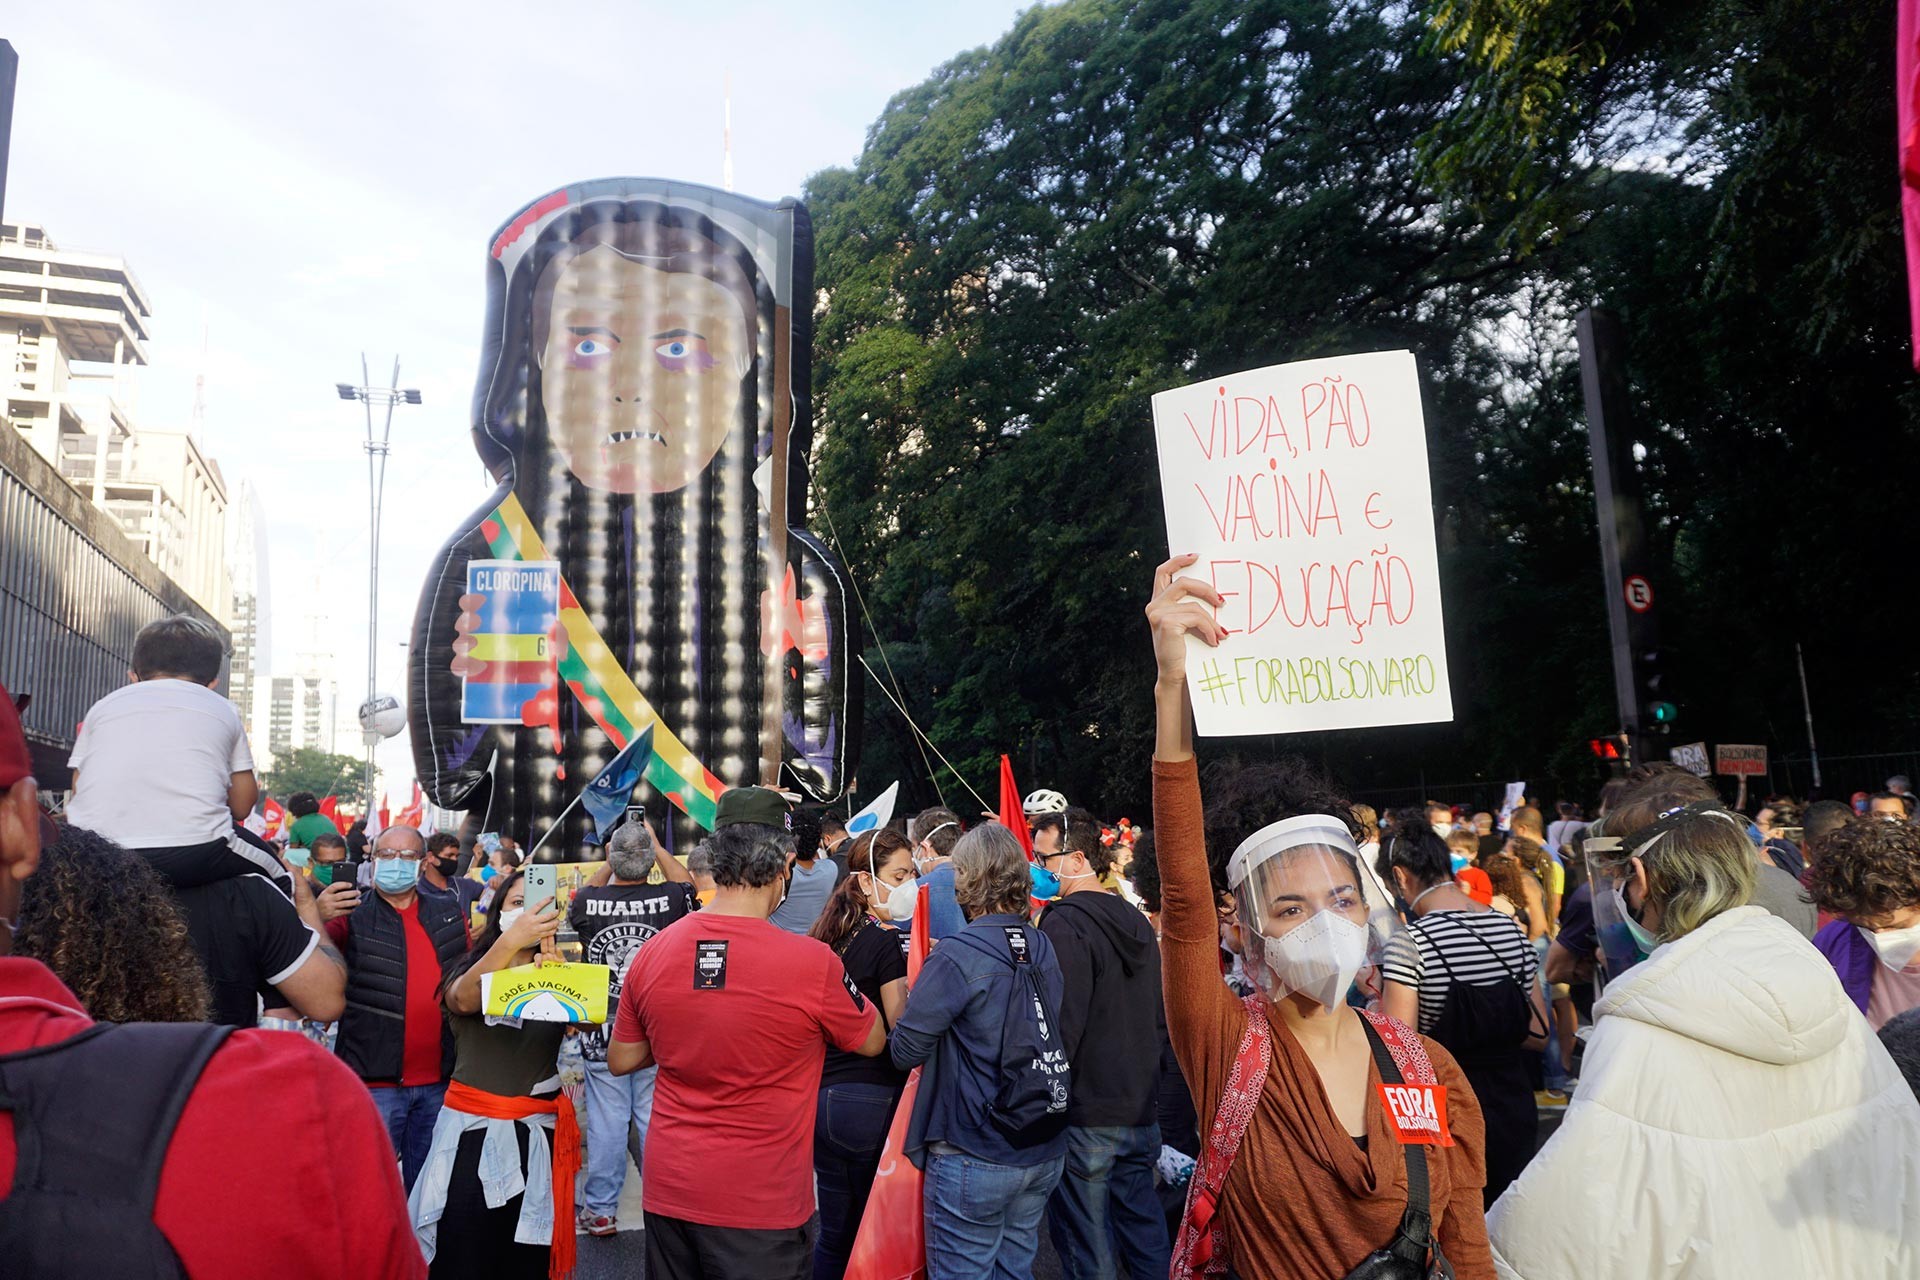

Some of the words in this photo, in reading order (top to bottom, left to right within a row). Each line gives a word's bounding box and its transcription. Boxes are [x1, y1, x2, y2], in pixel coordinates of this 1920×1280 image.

[1301, 374, 1371, 452] PÃO
[1194, 457, 1343, 542] VACINA
[476, 571, 552, 592] CLOROPINA
[1209, 543, 1415, 645] EDUCAÇÃO
[1197, 653, 1436, 706] #FORABOLSONARO
[586, 896, 670, 916] DUARTE
[527, 982, 536, 990] A
[538, 980, 588, 1002] VACINA?
[1383, 1086, 1438, 1119] FORA
[1395, 1115, 1440, 1133] BOLSONARO
